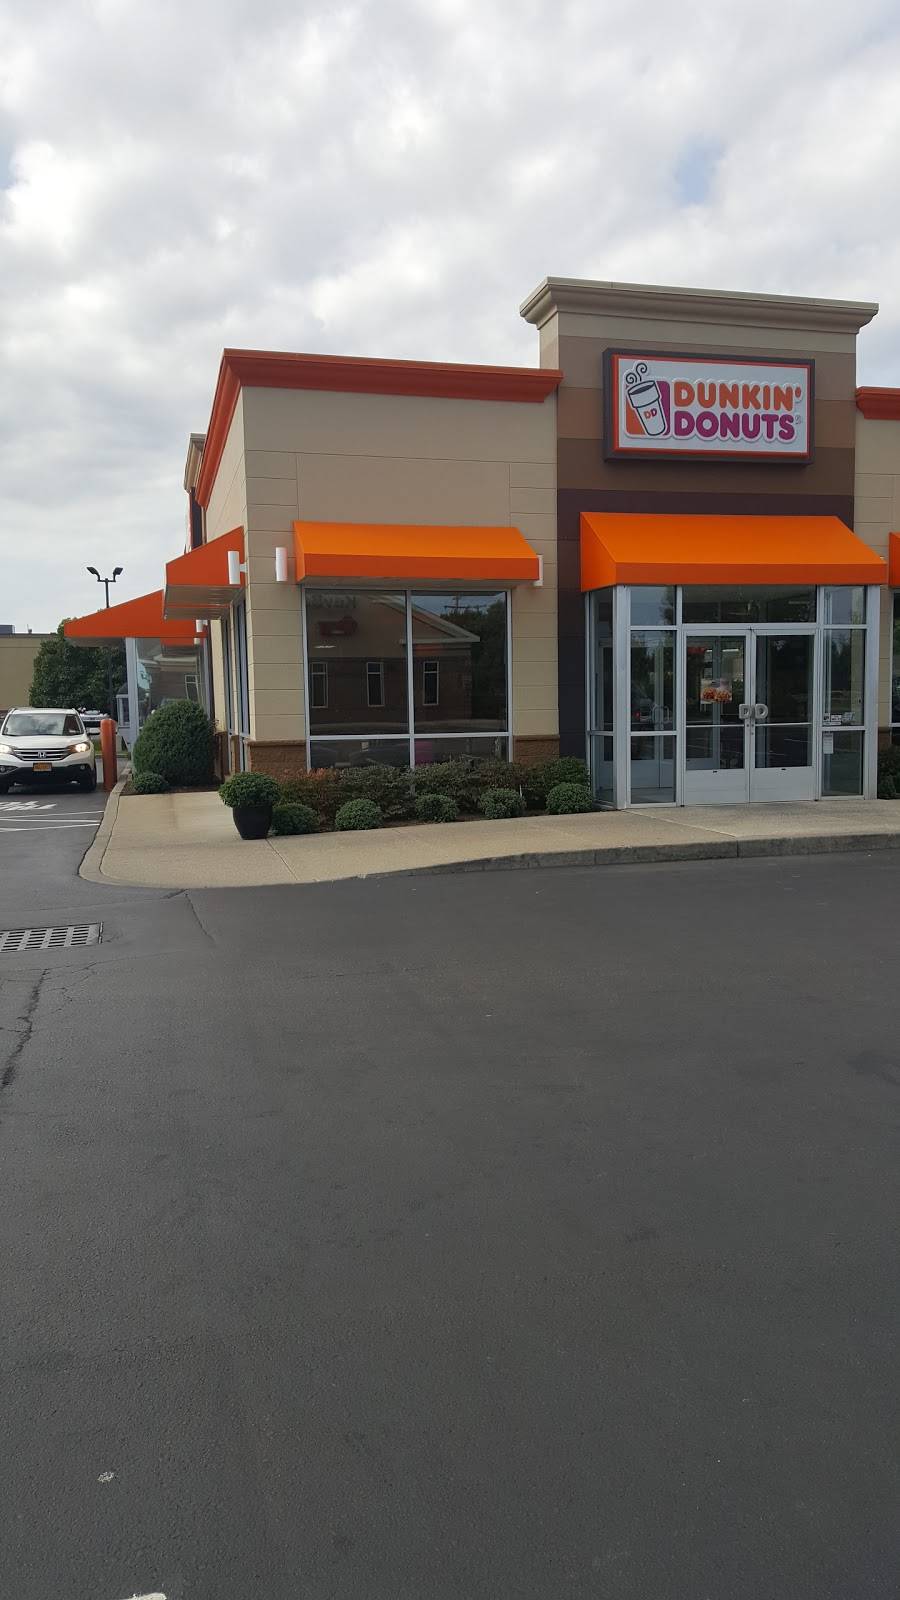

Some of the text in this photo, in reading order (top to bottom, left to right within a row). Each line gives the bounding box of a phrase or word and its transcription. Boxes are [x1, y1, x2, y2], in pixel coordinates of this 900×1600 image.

[674, 381, 801, 411] DUNKIN'
[644, 408, 657, 419] DD
[674, 411, 795, 440] DONUTS
